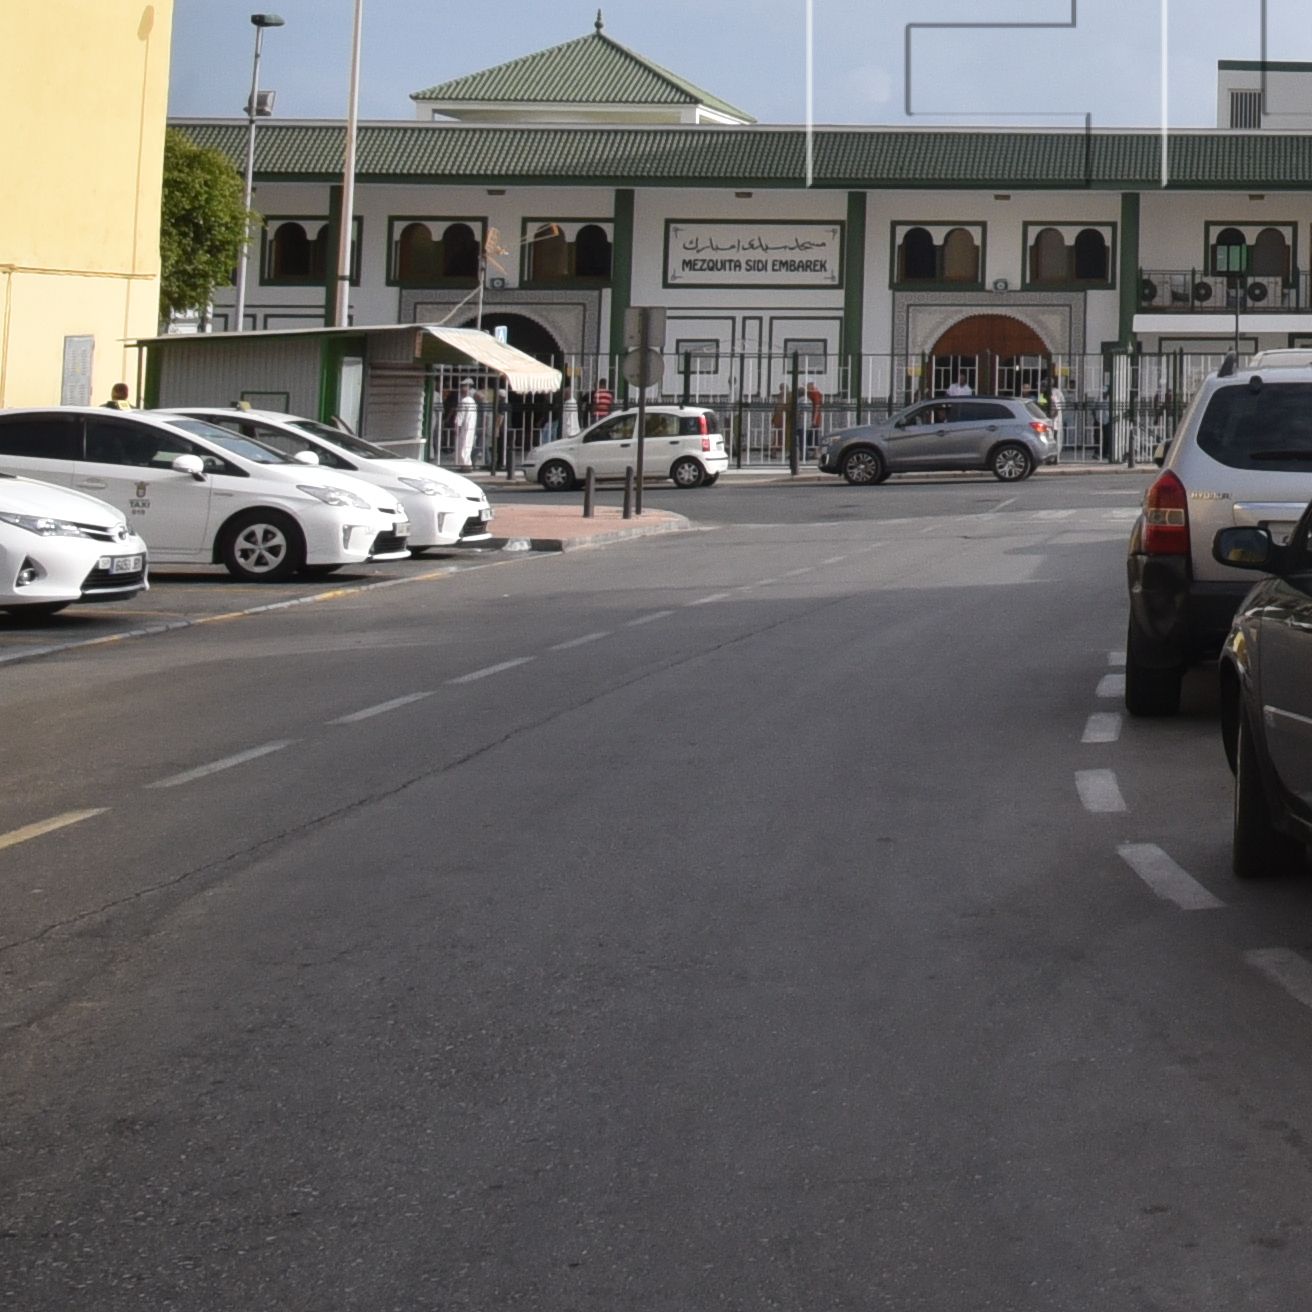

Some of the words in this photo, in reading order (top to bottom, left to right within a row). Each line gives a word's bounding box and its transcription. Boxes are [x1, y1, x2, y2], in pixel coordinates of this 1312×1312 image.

[681, 258, 742, 272] MEZQUITA
[745, 259, 768, 272] SIDI
[771, 259, 827, 272] EMBAREK
[129, 499, 150, 508] TAXI
